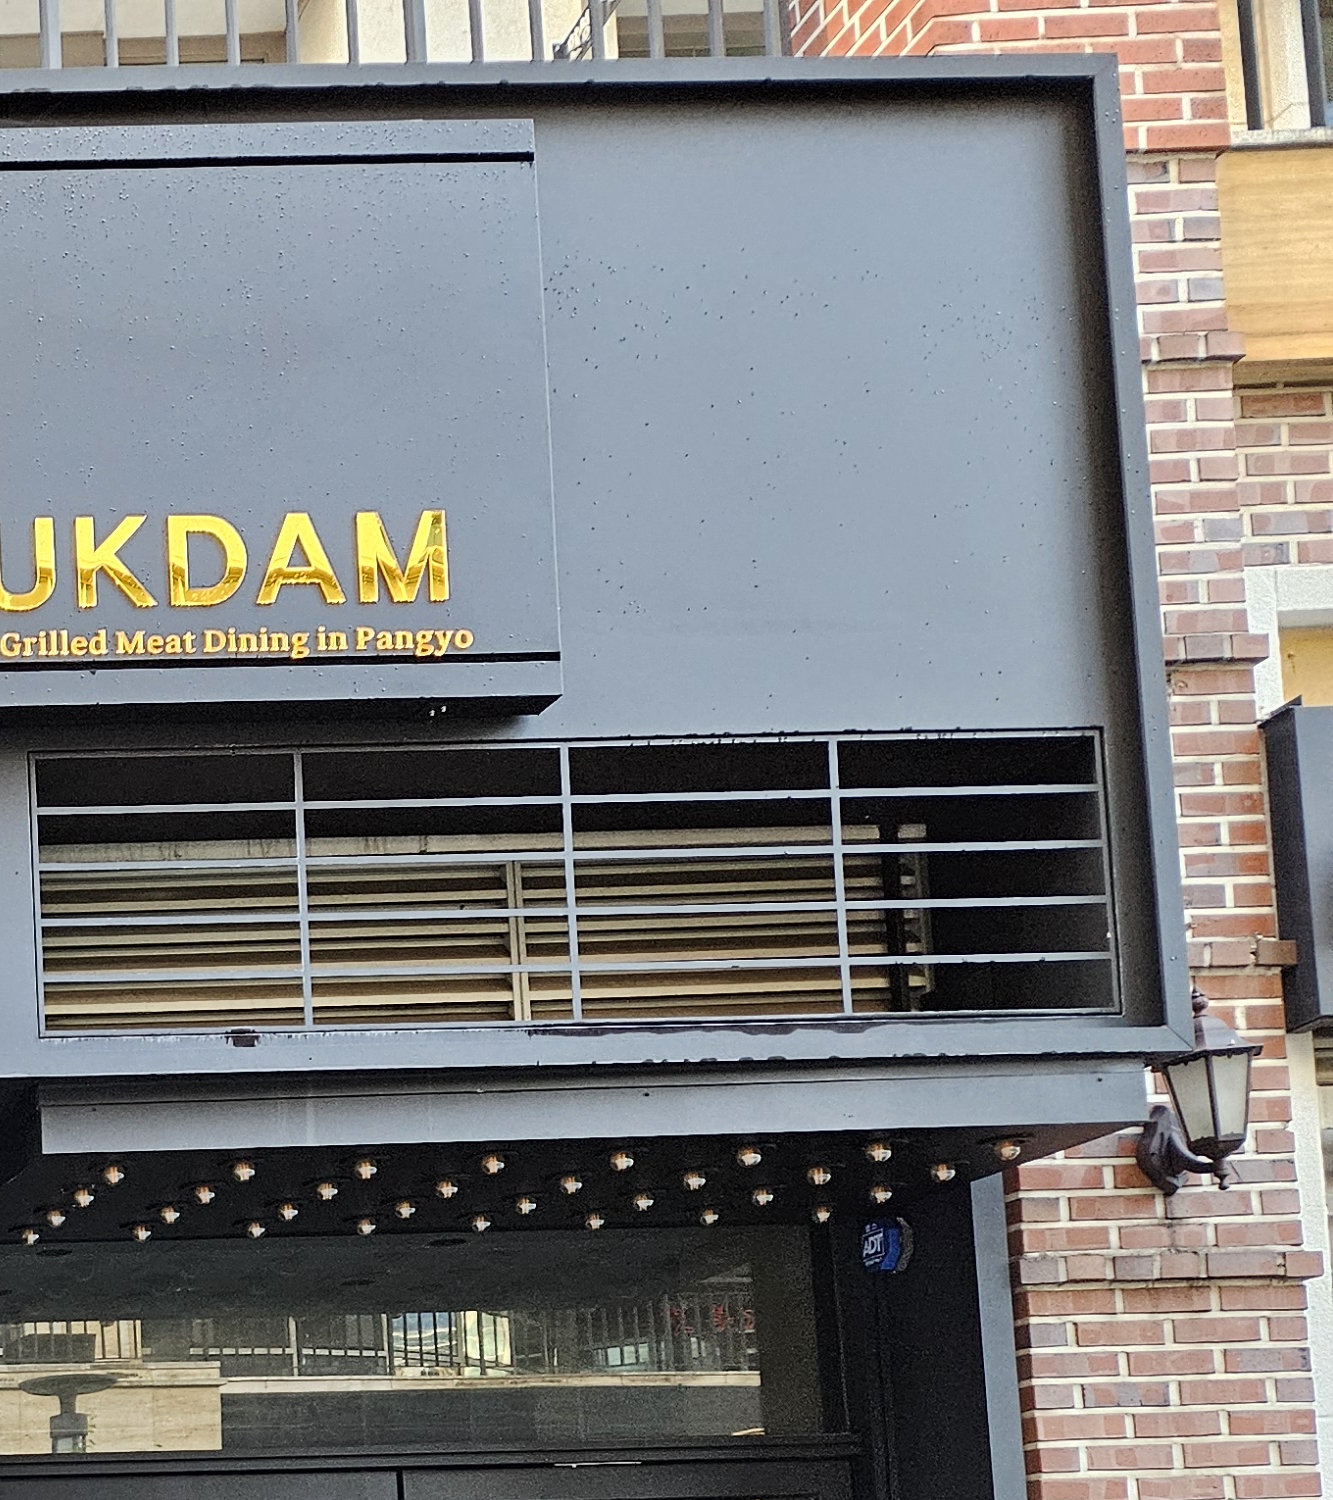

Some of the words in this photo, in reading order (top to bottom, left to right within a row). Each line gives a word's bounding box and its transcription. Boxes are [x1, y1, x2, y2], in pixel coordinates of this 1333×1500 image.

[0, 629, 107, 657] Grilled
[116, 631, 195, 655] Meat
[203, 628, 308, 658] Dining
[317, 627, 348, 651] in
[356, 626, 473, 657] Pangyo
